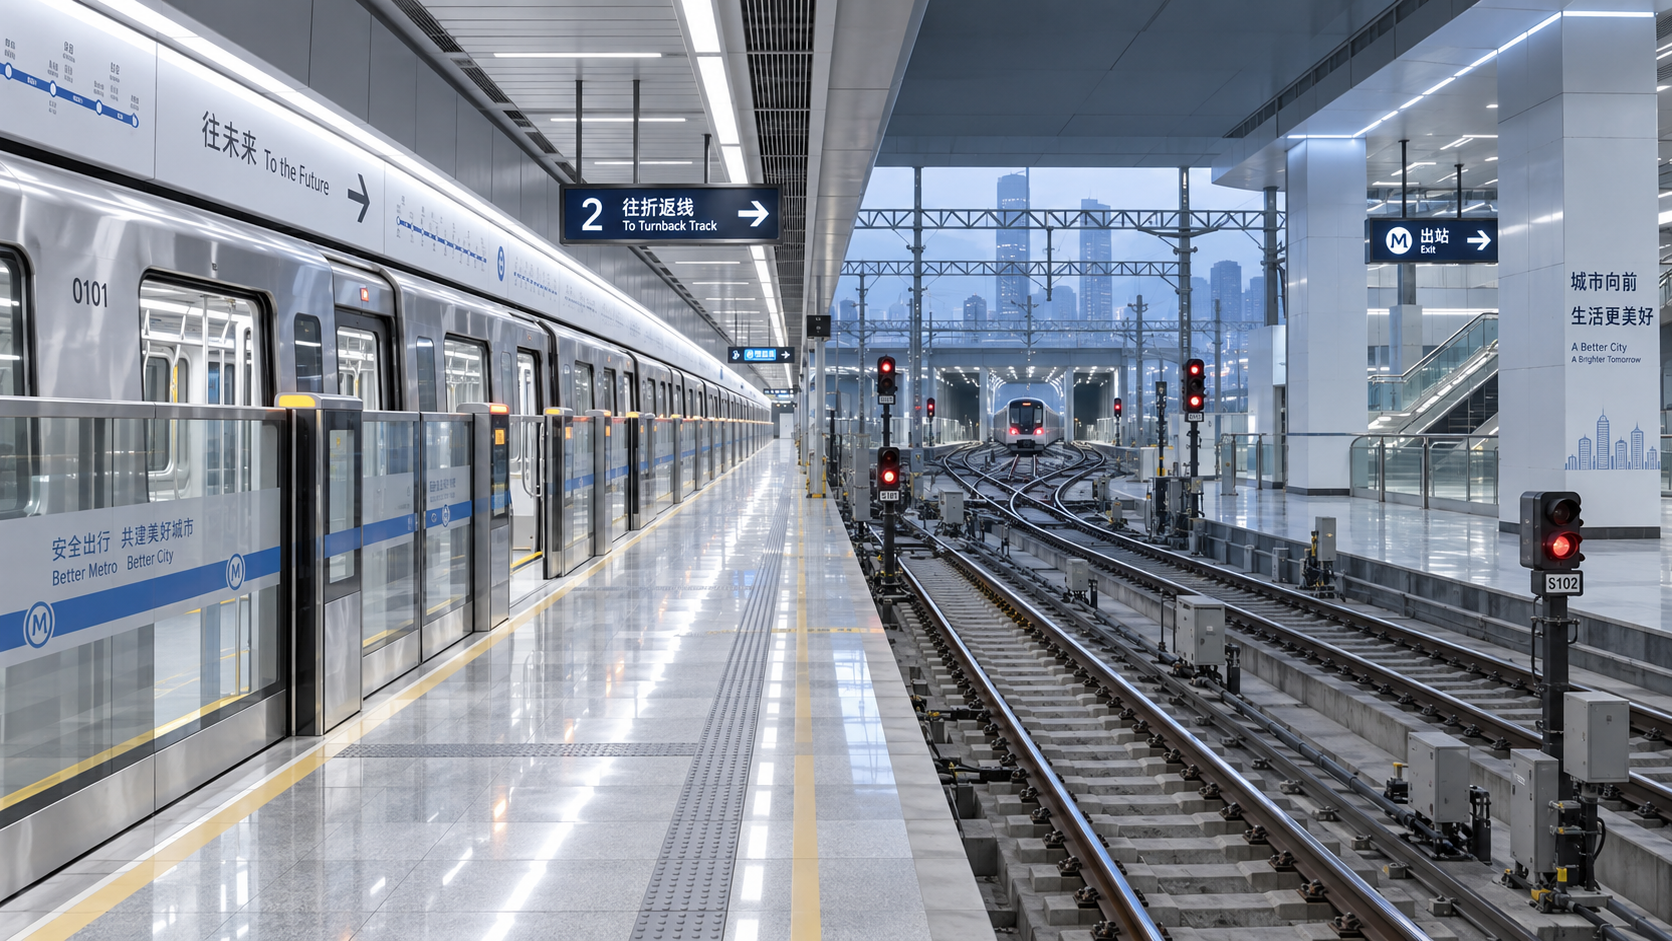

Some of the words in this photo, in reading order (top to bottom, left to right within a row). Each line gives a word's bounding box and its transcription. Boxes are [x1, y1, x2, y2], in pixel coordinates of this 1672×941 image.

[202, 110, 257, 166] 往未来
[264, 149, 277, 173] To
[280, 157, 297, 182] the
[299, 164, 330, 196] Future
[581, 197, 603, 232] 2
[622, 197, 695, 217] 往折返线
[622, 220, 636, 231] To
[638, 219, 687, 232] Turnback
[689, 219, 718, 232] Track
[1420, 227, 1450, 244] 出站
[1420, 245, 1437, 254] Exit
[1570, 271, 1638, 292] 城市向前
[72, 277, 108, 308] 0101
[1571, 305, 1654, 326] 生活更美好
[1571, 342, 1579, 352] A
[1580, 342, 1608, 352] Better
[1610, 342, 1628, 354] City
[1571, 355, 1577, 363] A
[1578, 355, 1606, 365] Brighter
[1607, 355, 1642, 363] Tomorrow
[52, 530, 111, 562] 安全出行
[121, 517, 194, 550] 共建美好城市
[52, 566, 86, 586] Better
[88, 561, 118, 579] Metro
[127, 553, 155, 571] Better
[157, 548, 175, 565] City
[1548, 577, 1578, 590] S102
